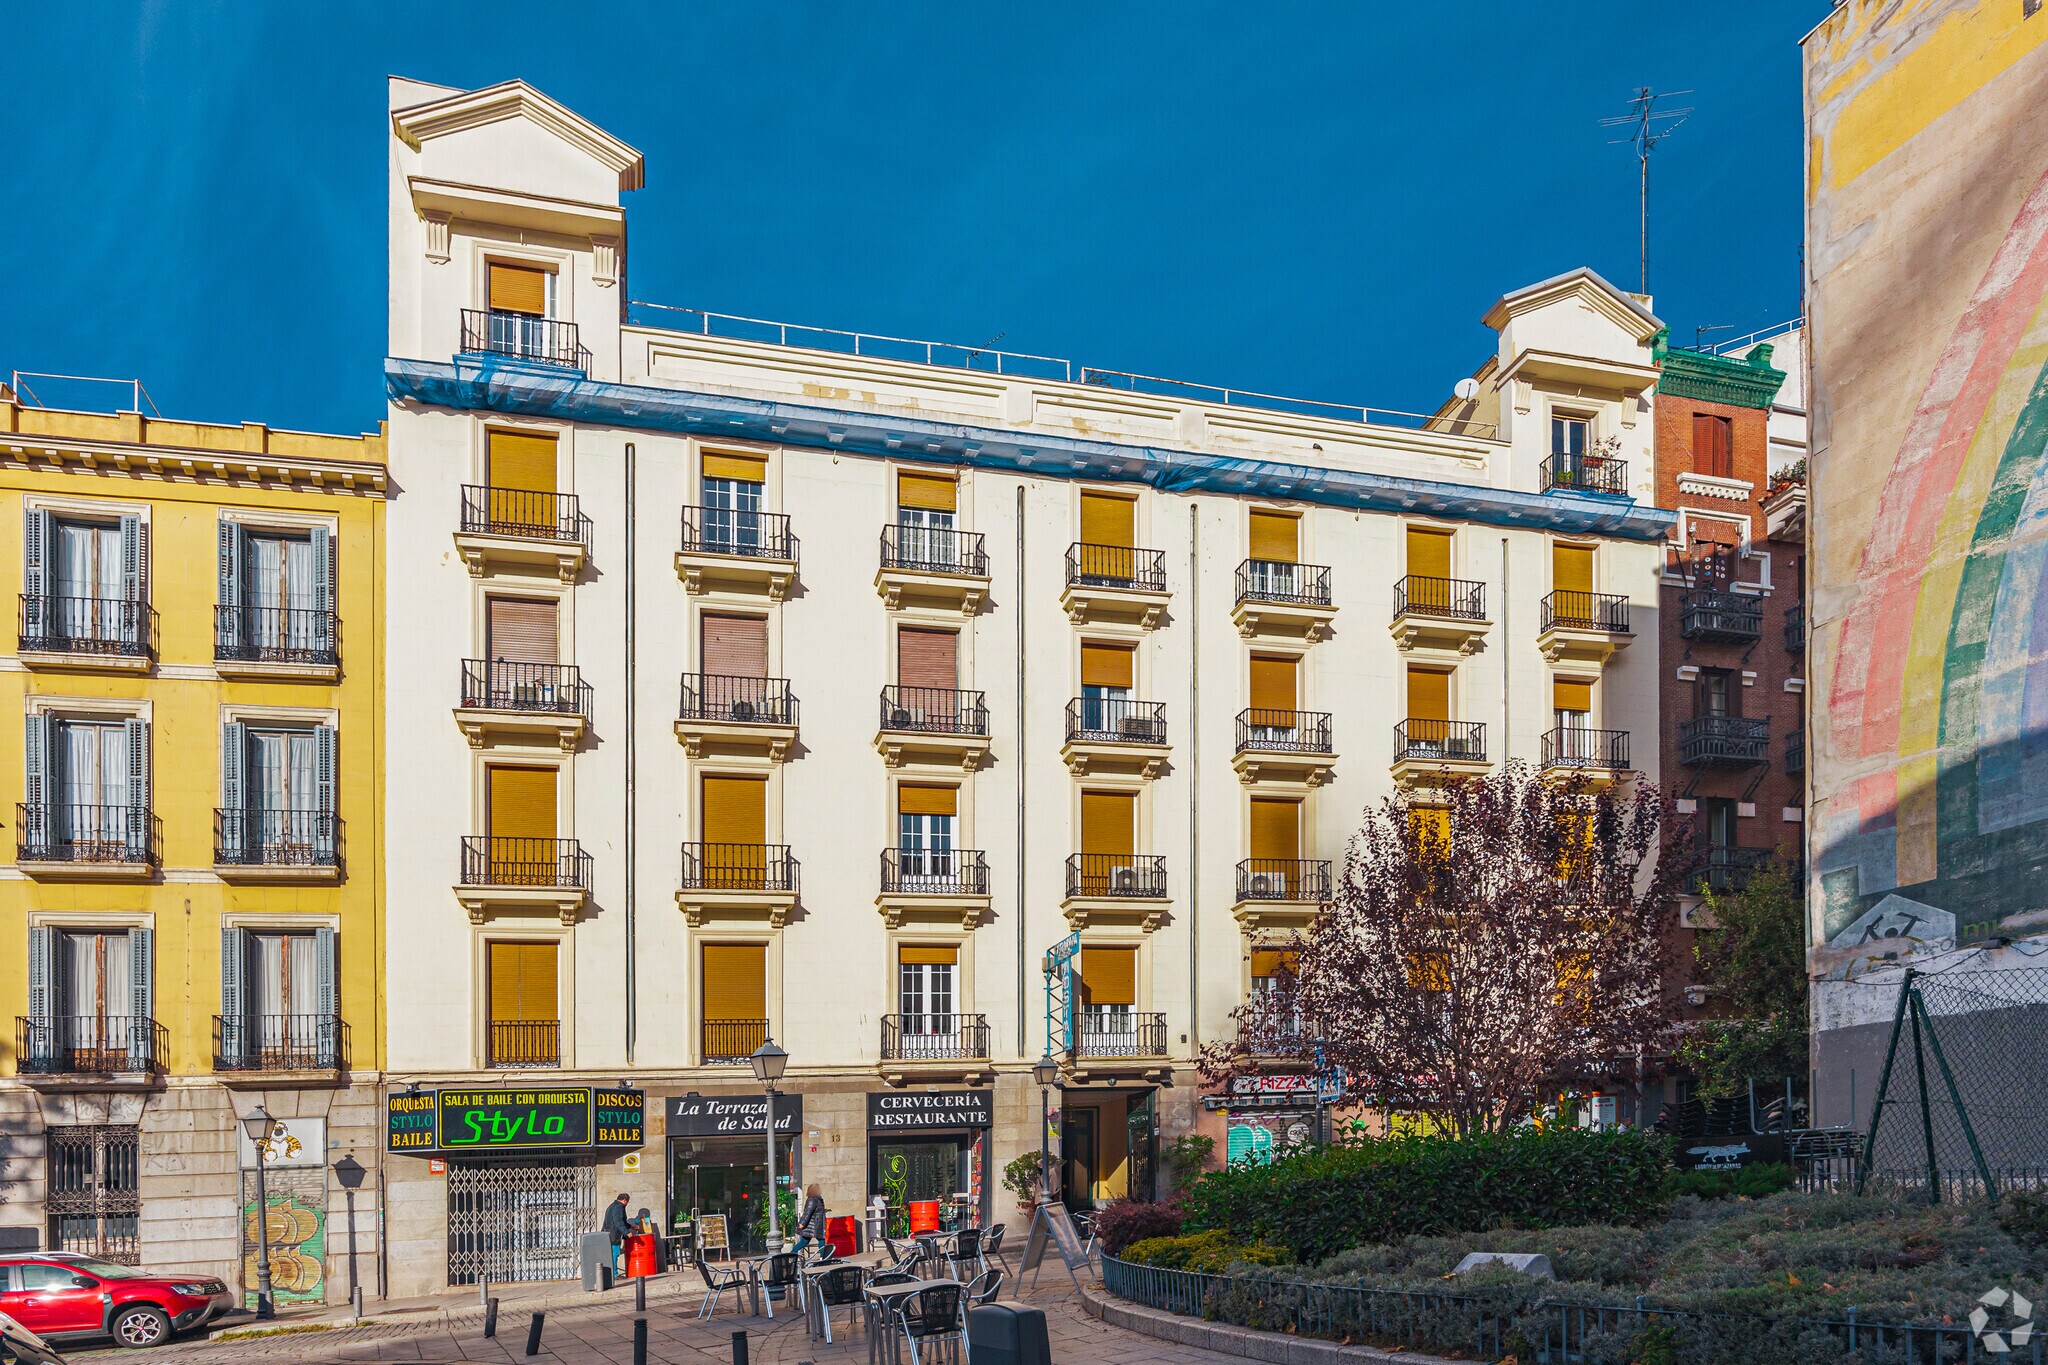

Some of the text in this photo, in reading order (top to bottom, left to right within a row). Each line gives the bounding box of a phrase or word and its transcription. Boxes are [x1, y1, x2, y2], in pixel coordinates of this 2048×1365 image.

[1260, 1076, 1308, 1090] PIZZA
[390, 1096, 435, 1113] ORQUESTA
[445, 1092, 586, 1106] SALA DE BAILE CON ORQUESTA
[597, 1093, 643, 1107] DISCOS
[880, 1093, 982, 1109] CERVECERÍA
[676, 1100, 768, 1116] La Terraza
[391, 1114, 433, 1129] STYLO
[597, 1111, 641, 1124] STYLO
[717, 1115, 792, 1131] de Salud
[873, 1111, 988, 1126] RESTAURANTE
[450, 1109, 565, 1143] Stylo
[391, 1132, 433, 1147] BAILE
[598, 1128, 641, 1141] BAILE
[831, 1134, 841, 1143] 13
